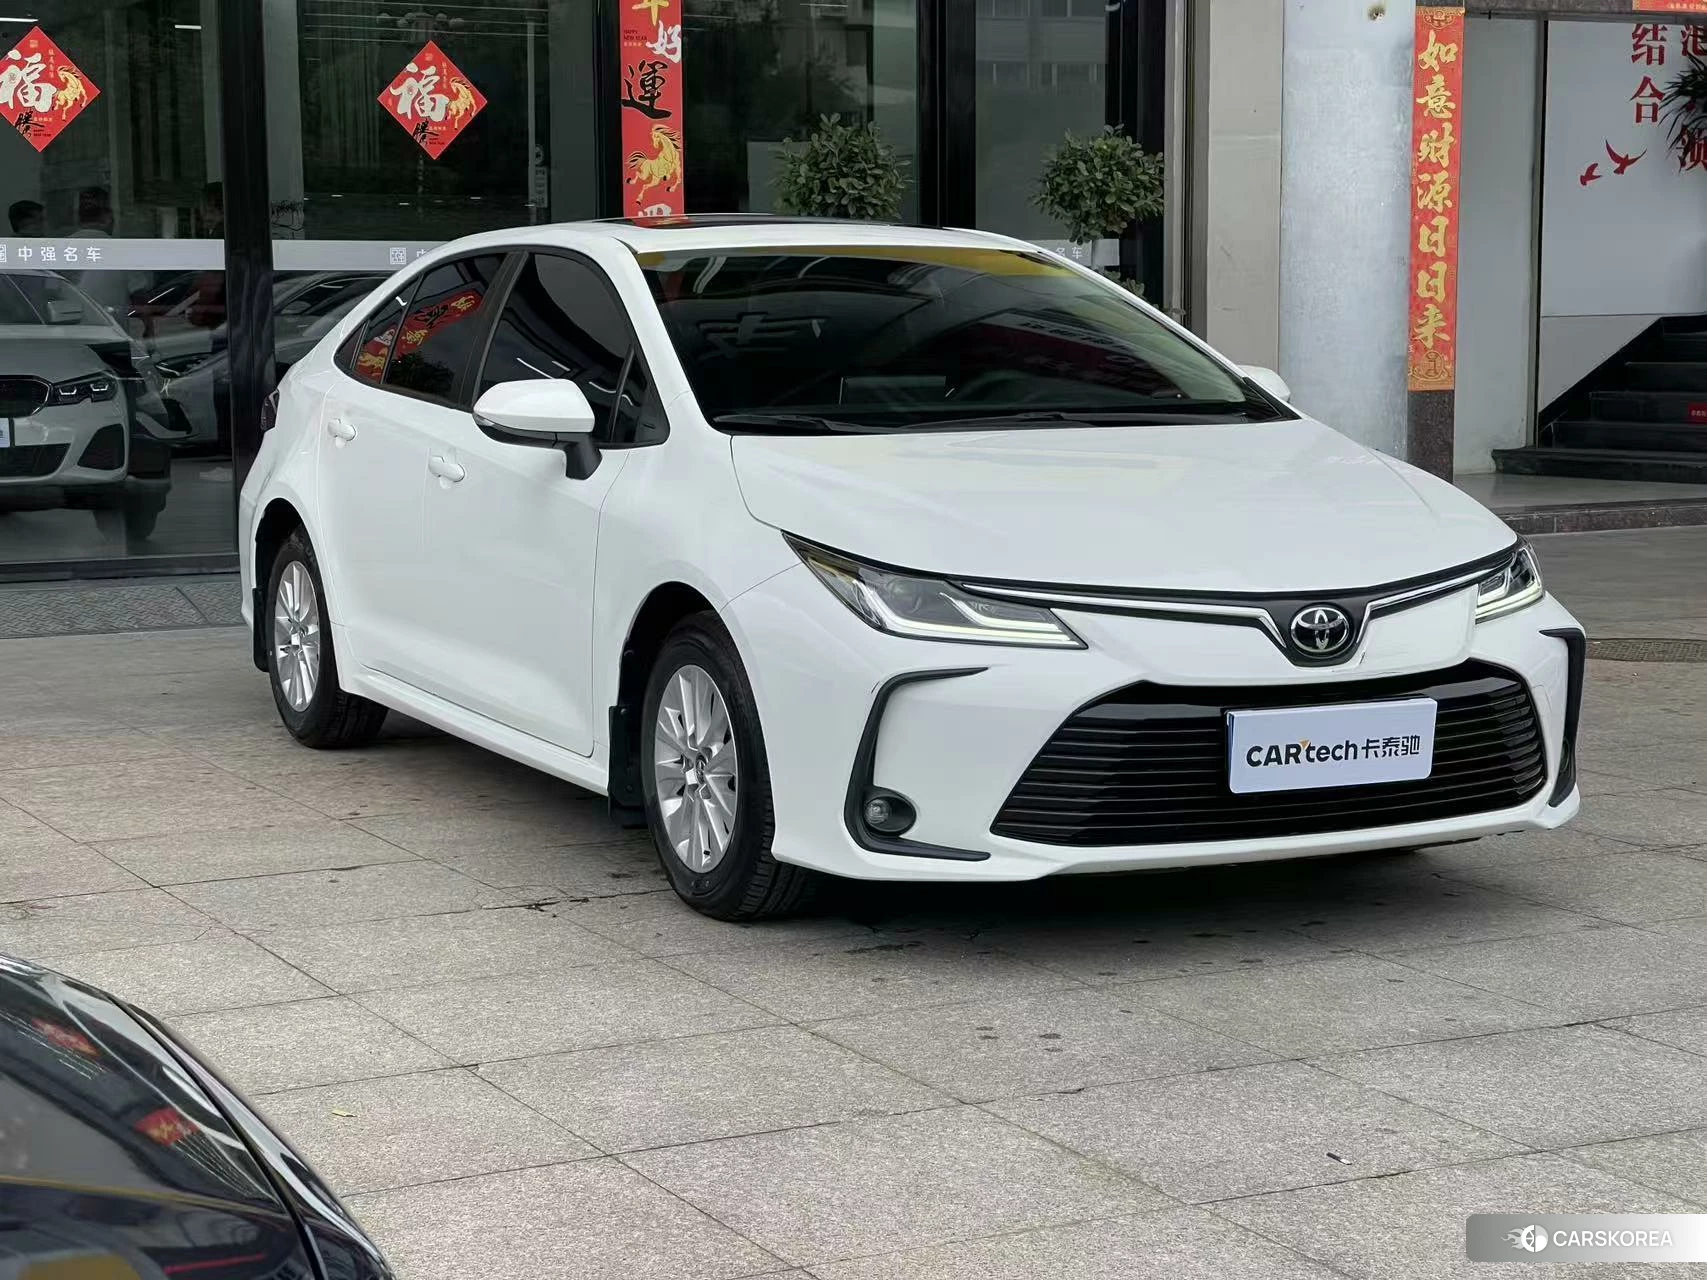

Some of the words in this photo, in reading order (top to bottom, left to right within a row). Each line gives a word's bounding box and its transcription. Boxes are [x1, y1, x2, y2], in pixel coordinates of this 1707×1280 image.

[0, 49, 58, 113] 福
[390, 62, 450, 122] 福
[1414, 29, 1458, 349] 如意财源日日来
[18, 245, 102, 262] 中强名车
[1246, 739, 1358, 767] CARtech
[1361, 735, 1421, 759] 卡泰驰
